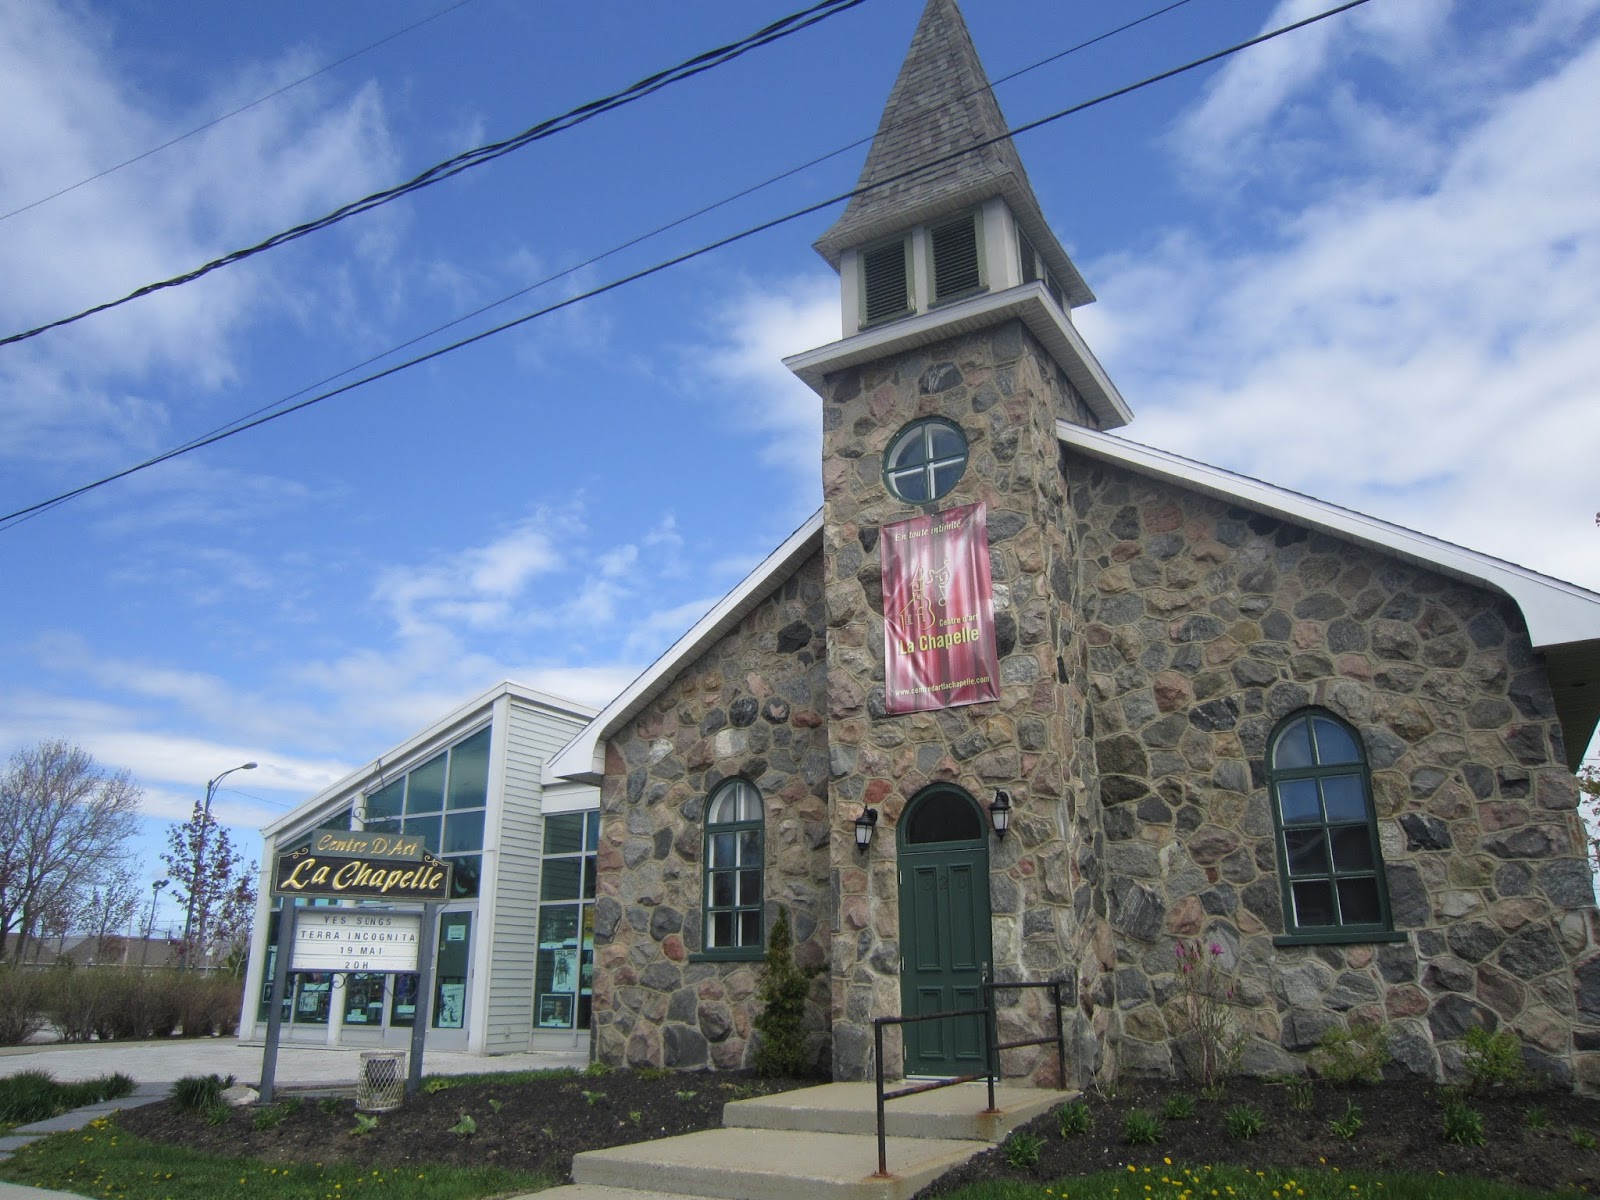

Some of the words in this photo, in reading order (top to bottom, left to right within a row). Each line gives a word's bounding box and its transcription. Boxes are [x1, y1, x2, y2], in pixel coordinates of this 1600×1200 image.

[895, 532, 906, 542] En
[909, 529, 929, 540] toute
[939, 616, 961, 627] Centre
[962, 613, 979, 623] d'art
[899, 640, 915, 656] La
[919, 627, 980, 652] Chapelle
[895, 675, 990, 696] www.centredartlachapelle.com
[317, 834, 369, 853] Centre
[371, 837, 418, 857] D'Art
[280, 858, 332, 890] La
[332, 860, 444, 893] Chapelle
[324, 916, 346, 925] YES
[356, 916, 392, 926] SONGS
[301, 930, 341, 940] TERRA
[347, 932, 416, 942] INCOGNITA
[340, 946, 353, 955] 19
[360, 946, 383, 955] MAI
[345, 961, 369, 969] 20H
